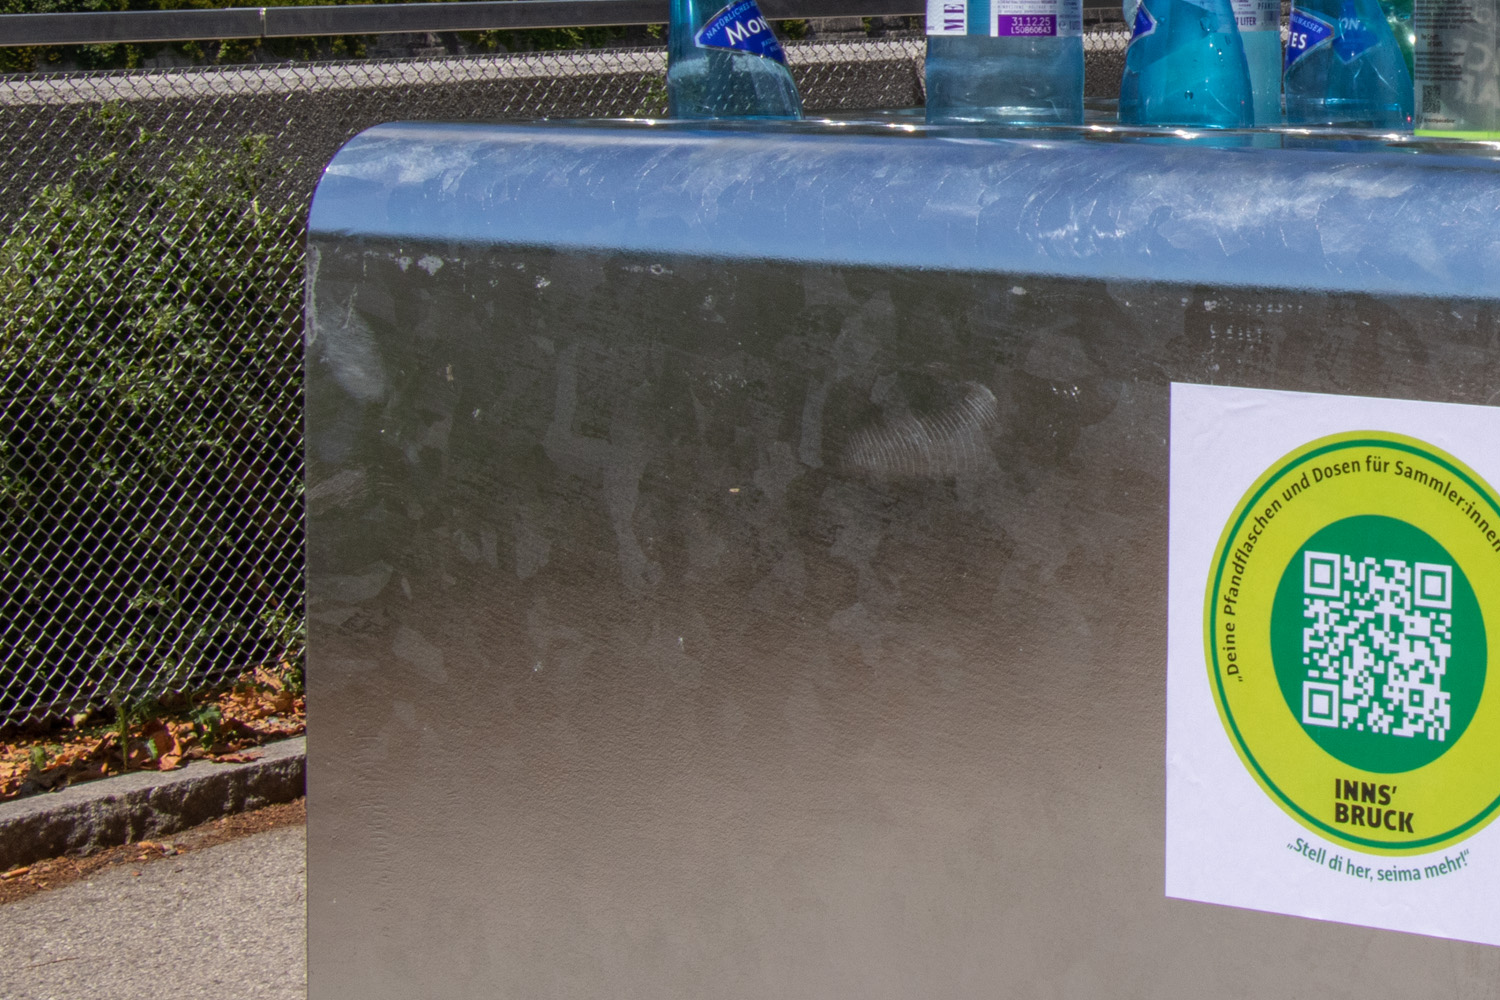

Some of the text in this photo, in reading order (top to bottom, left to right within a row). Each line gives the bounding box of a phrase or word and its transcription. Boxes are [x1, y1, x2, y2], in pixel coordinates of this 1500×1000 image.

[705, 2, 752, 40] NATÜRLICHES
[1011, 16, 1051, 27] 31.12.25
[1240, 16, 1257, 26] LITER
[1223, 499, 1283, 617] Pfandflaschen
[1282, 472, 1311, 502] und
[1312, 459, 1361, 483] Dosen
[1365, 455, 1391, 473] für
[1335, 802, 1414, 834] BRUCK
[1328, 854, 1342, 872] di
[1346, 858, 1374, 882] her,
[1377, 865, 1421, 882] seima
